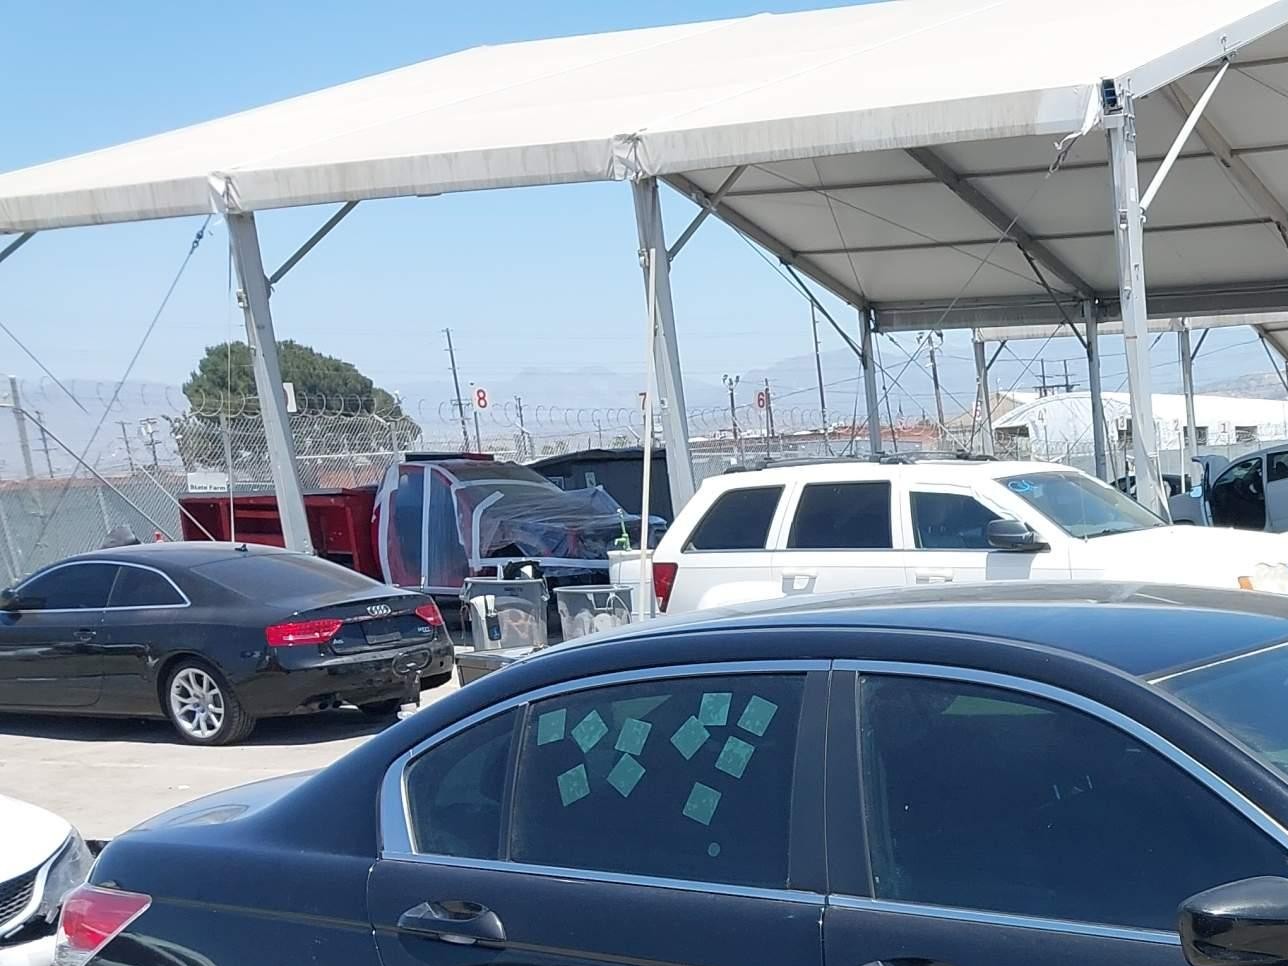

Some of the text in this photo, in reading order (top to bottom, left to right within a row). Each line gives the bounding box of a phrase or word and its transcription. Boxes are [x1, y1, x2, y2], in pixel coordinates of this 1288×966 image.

[476, 388, 488, 409] 8
[638, 391, 647, 411] 7
[757, 391, 765, 409] 6
[1220, 422, 1228, 434] 1
